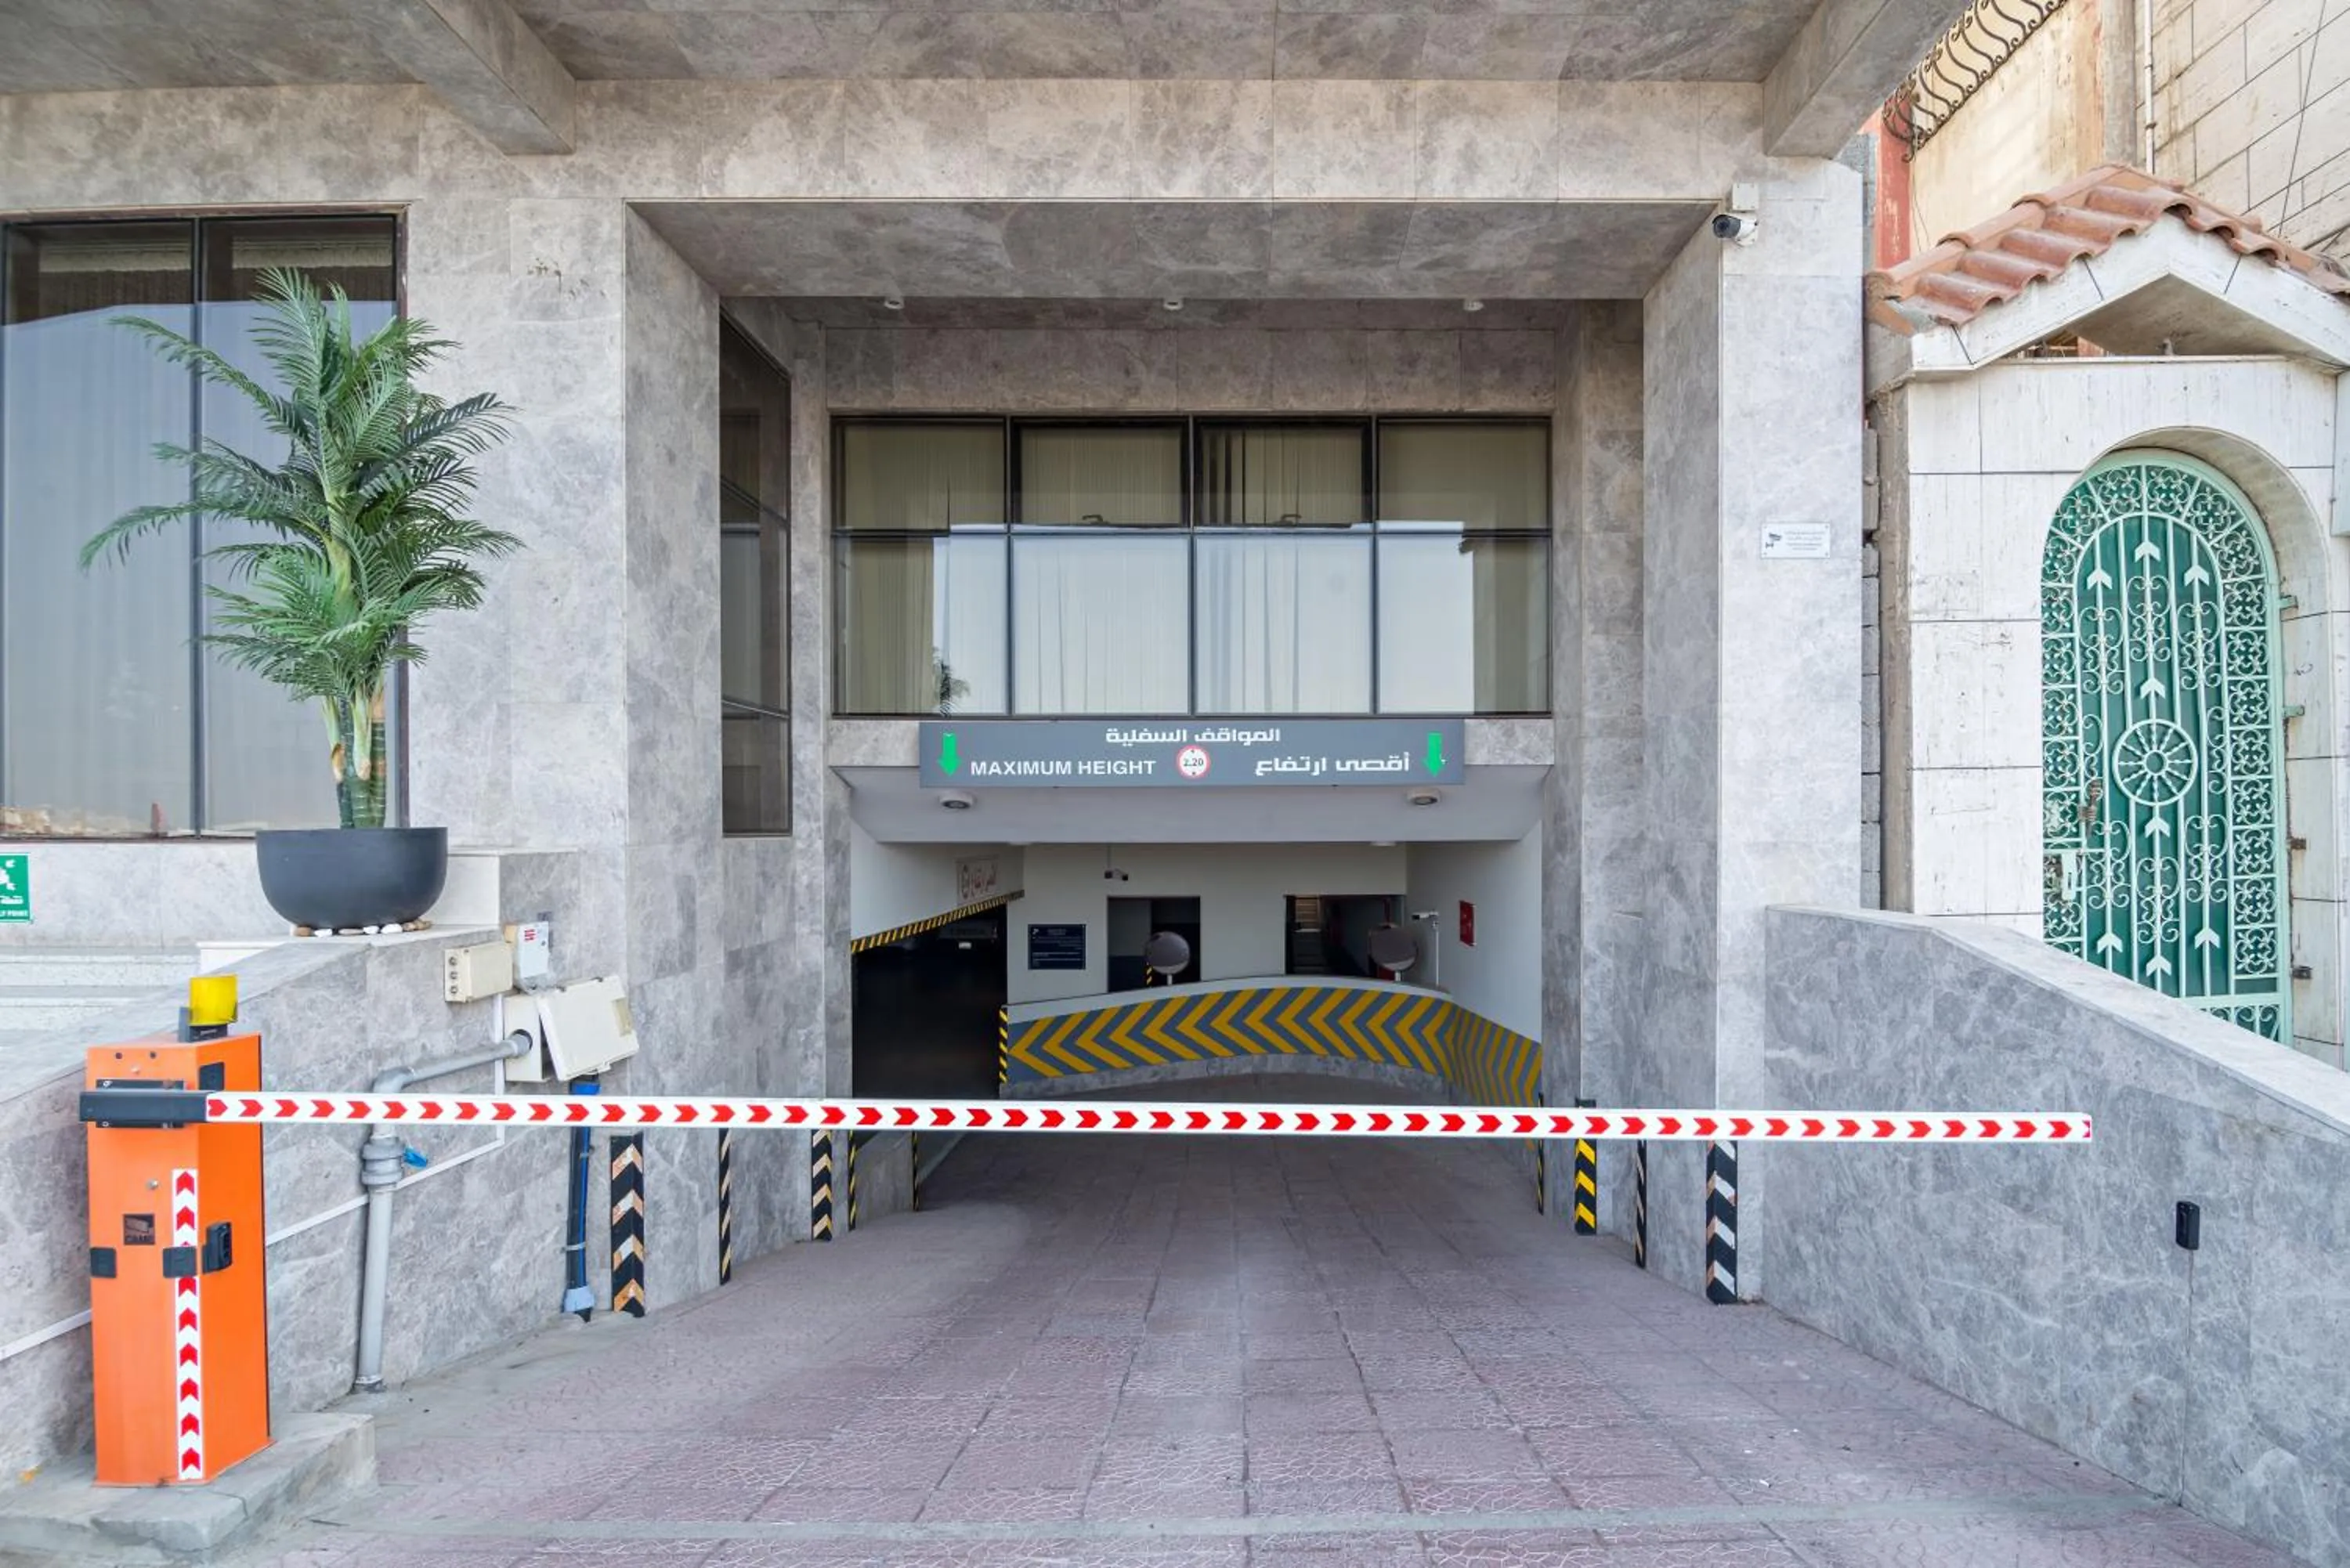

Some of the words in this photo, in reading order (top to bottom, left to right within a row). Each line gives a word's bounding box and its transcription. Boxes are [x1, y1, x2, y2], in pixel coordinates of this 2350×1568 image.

[1105, 728, 1187, 746] السفلية
[1195, 728, 1281, 746] المواقف
[971, 761, 1072, 775] MAXIMUM
[1078, 761, 1156, 775] HEIGHT
[1184, 757, 1204, 767] 2.20
[1255, 756, 1327, 776] ارتفاع
[1336, 751, 1409, 771] أقصى
